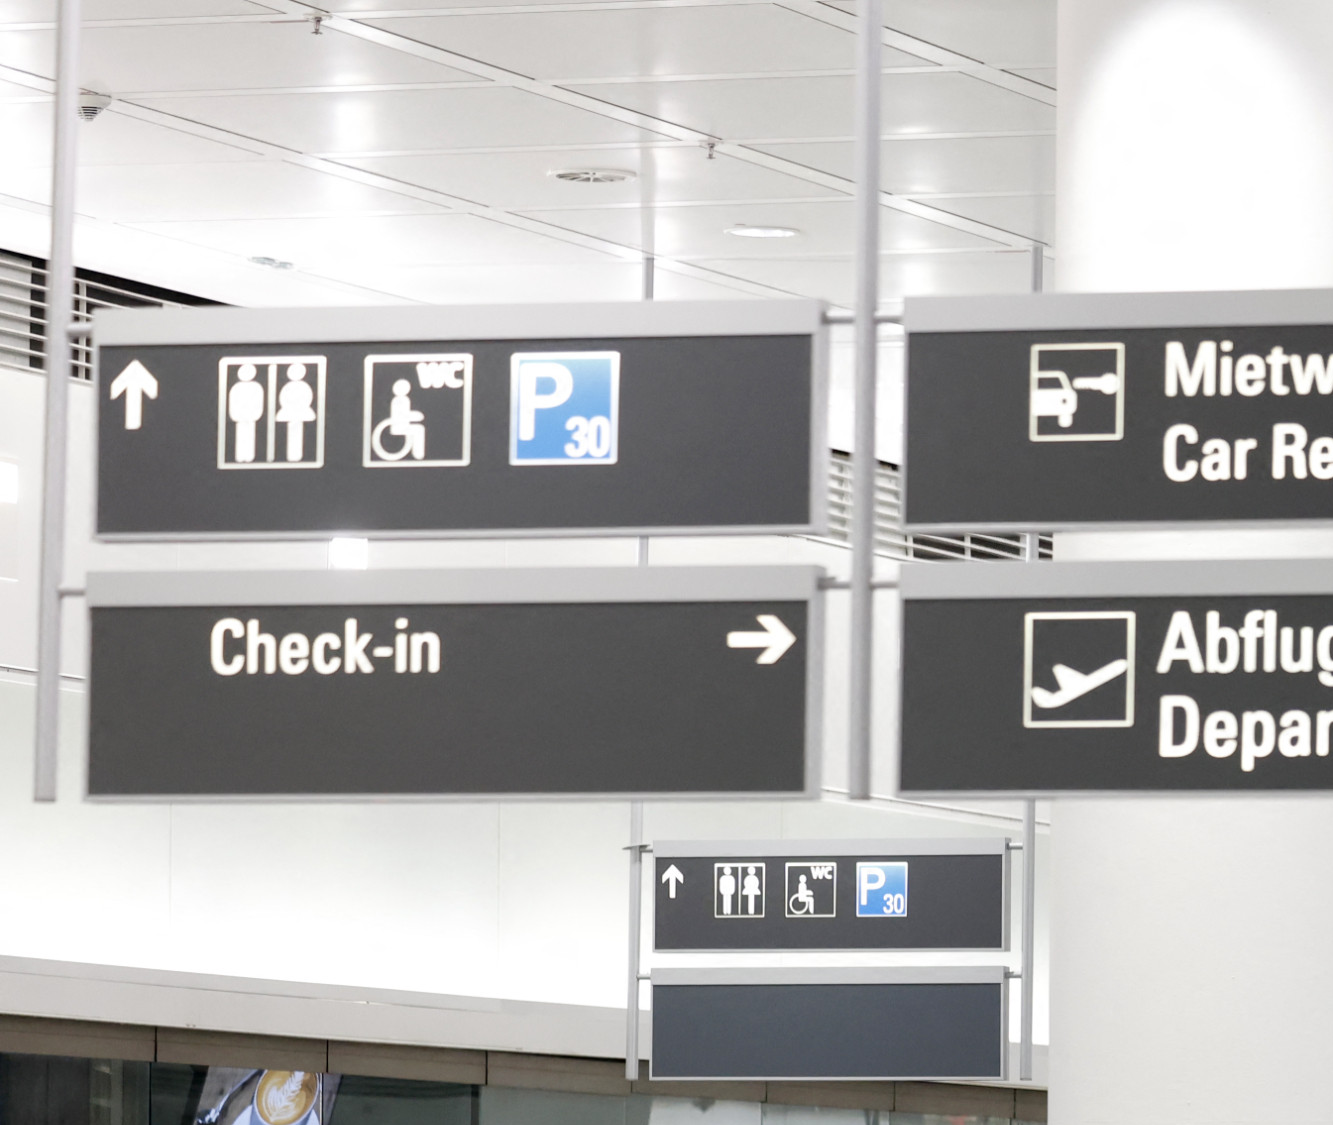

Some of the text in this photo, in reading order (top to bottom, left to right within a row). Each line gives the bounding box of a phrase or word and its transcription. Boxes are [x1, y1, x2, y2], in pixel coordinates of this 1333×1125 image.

[416, 361, 465, 391] WC
[517, 361, 574, 442] P
[565, 416, 611, 459] 30
[1163, 423, 1258, 482] Car
[210, 617, 441, 676] Check-in
[811, 866, 833, 881] WC
[860, 866, 886, 906] P
[883, 893, 905, 915] 30
